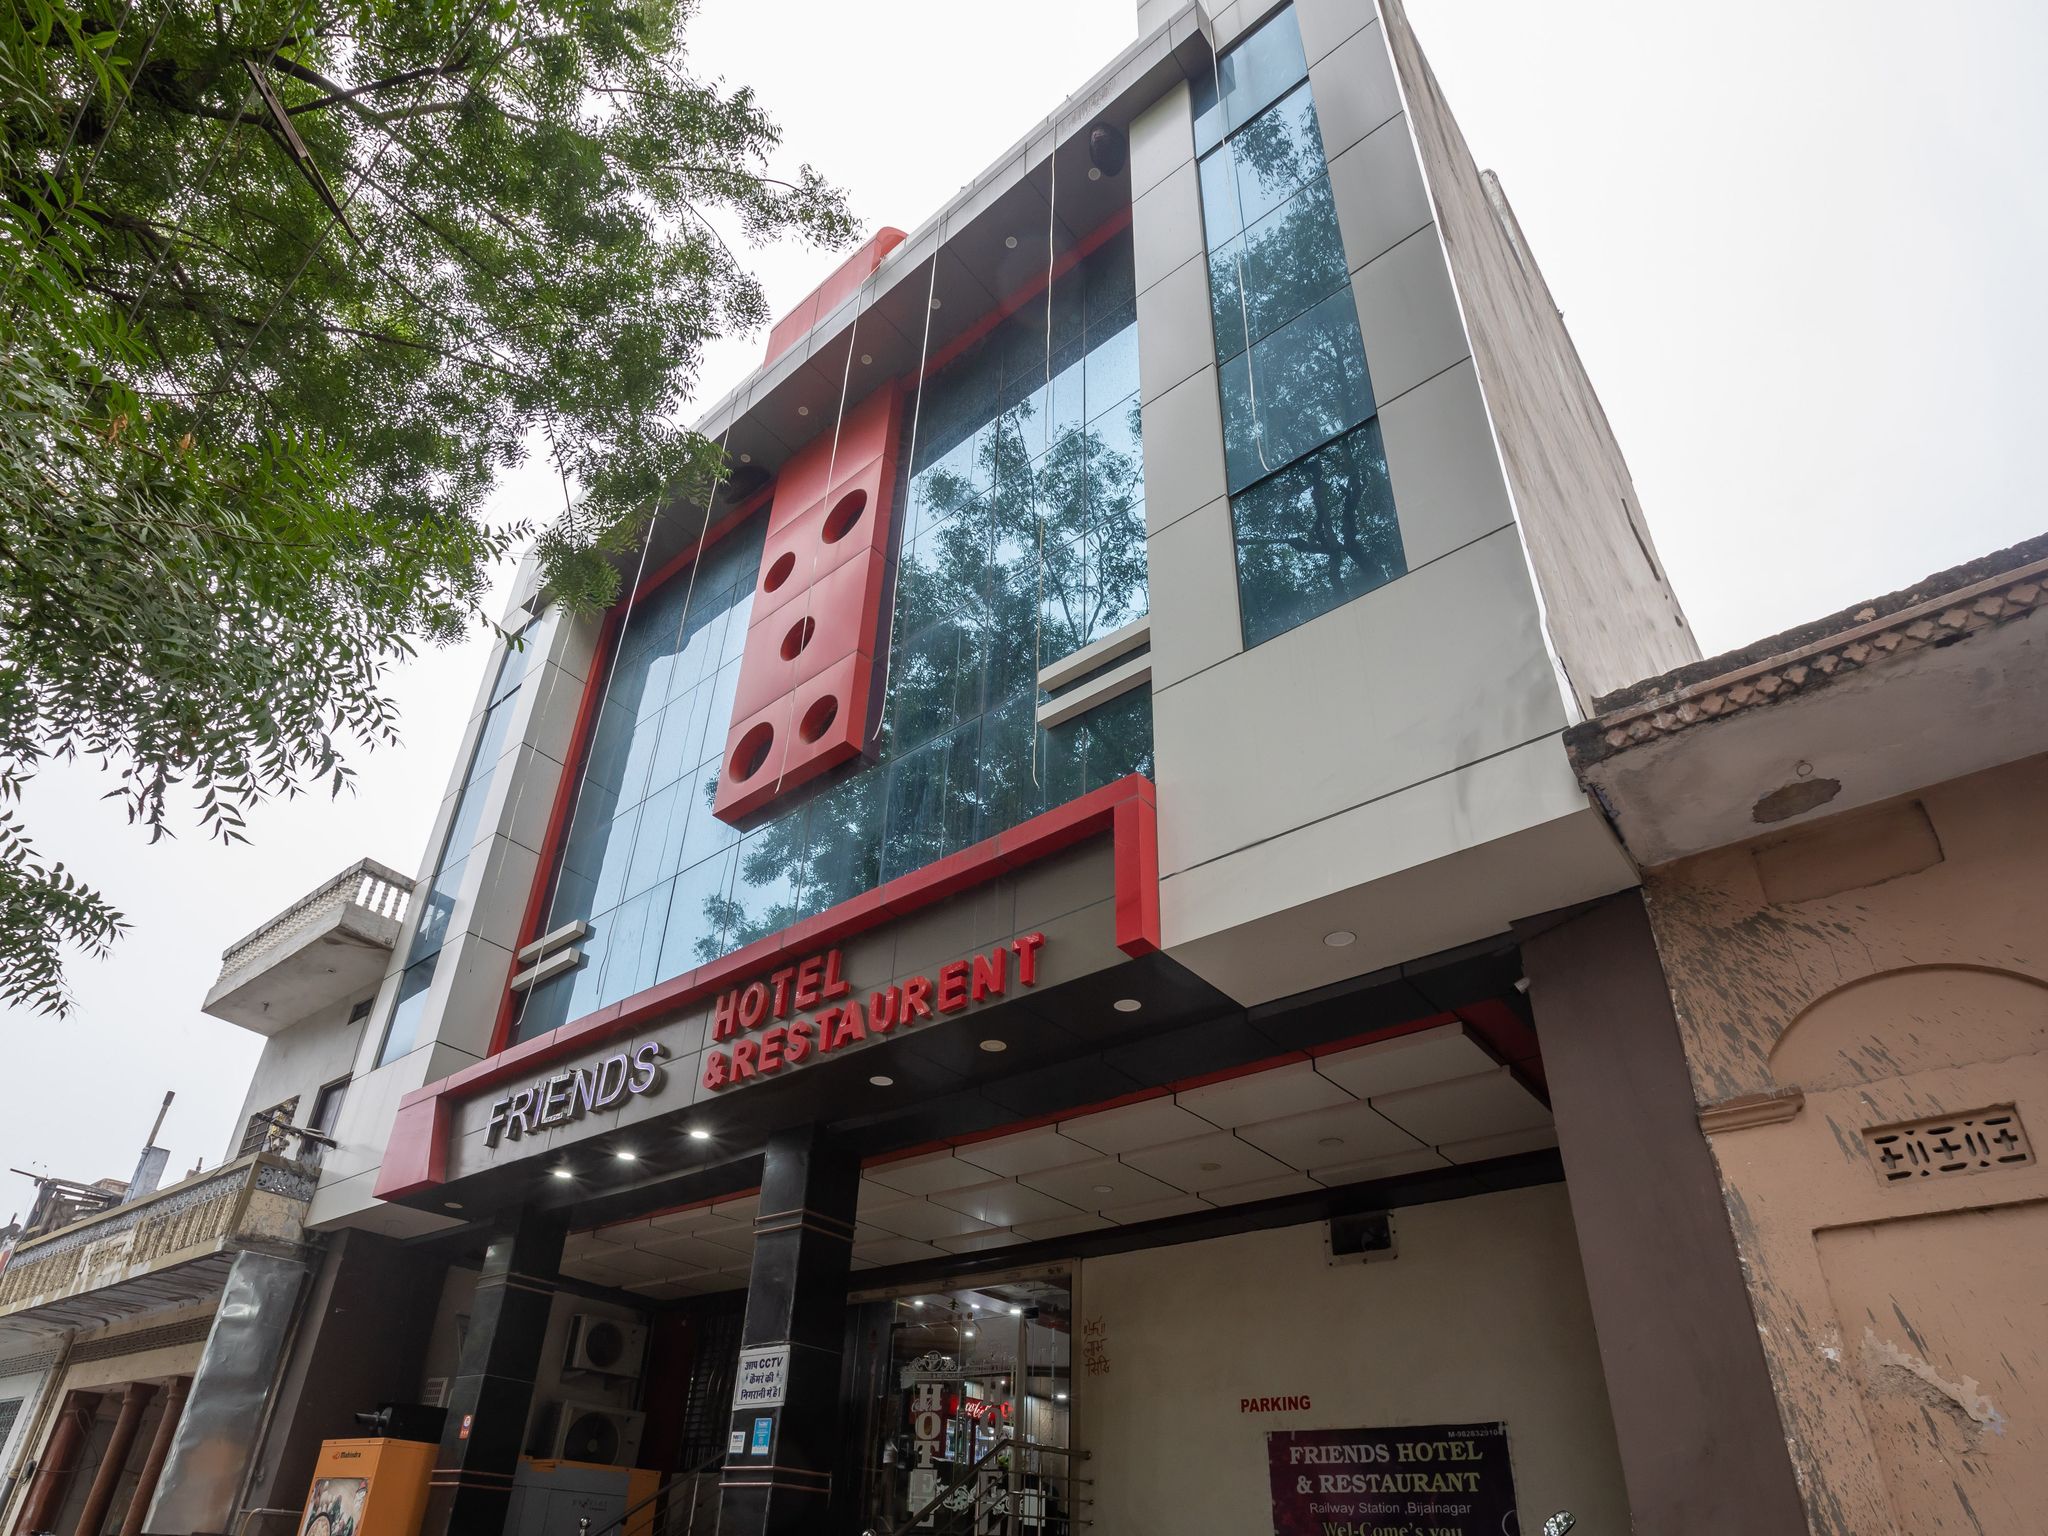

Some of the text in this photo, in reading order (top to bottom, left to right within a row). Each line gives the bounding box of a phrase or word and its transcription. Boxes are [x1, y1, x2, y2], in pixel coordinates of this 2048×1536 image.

[712, 948, 853, 1042] HOTEL
[484, 1041, 667, 1148] FRIENDS
[745, 1357, 783, 1370] आप CCTV
[765, 1372, 774, 1382] की
[741, 1387, 766, 1400] निगरानी
[1240, 1395, 1311, 1413] PARKING
[1289, 1441, 1484, 1465] FRIENDS HOTEL
[1296, 1472, 1481, 1494] & RESTAURANT
[1310, 1502, 1355, 1516] Railway
[1358, 1502, 1400, 1514] Station
